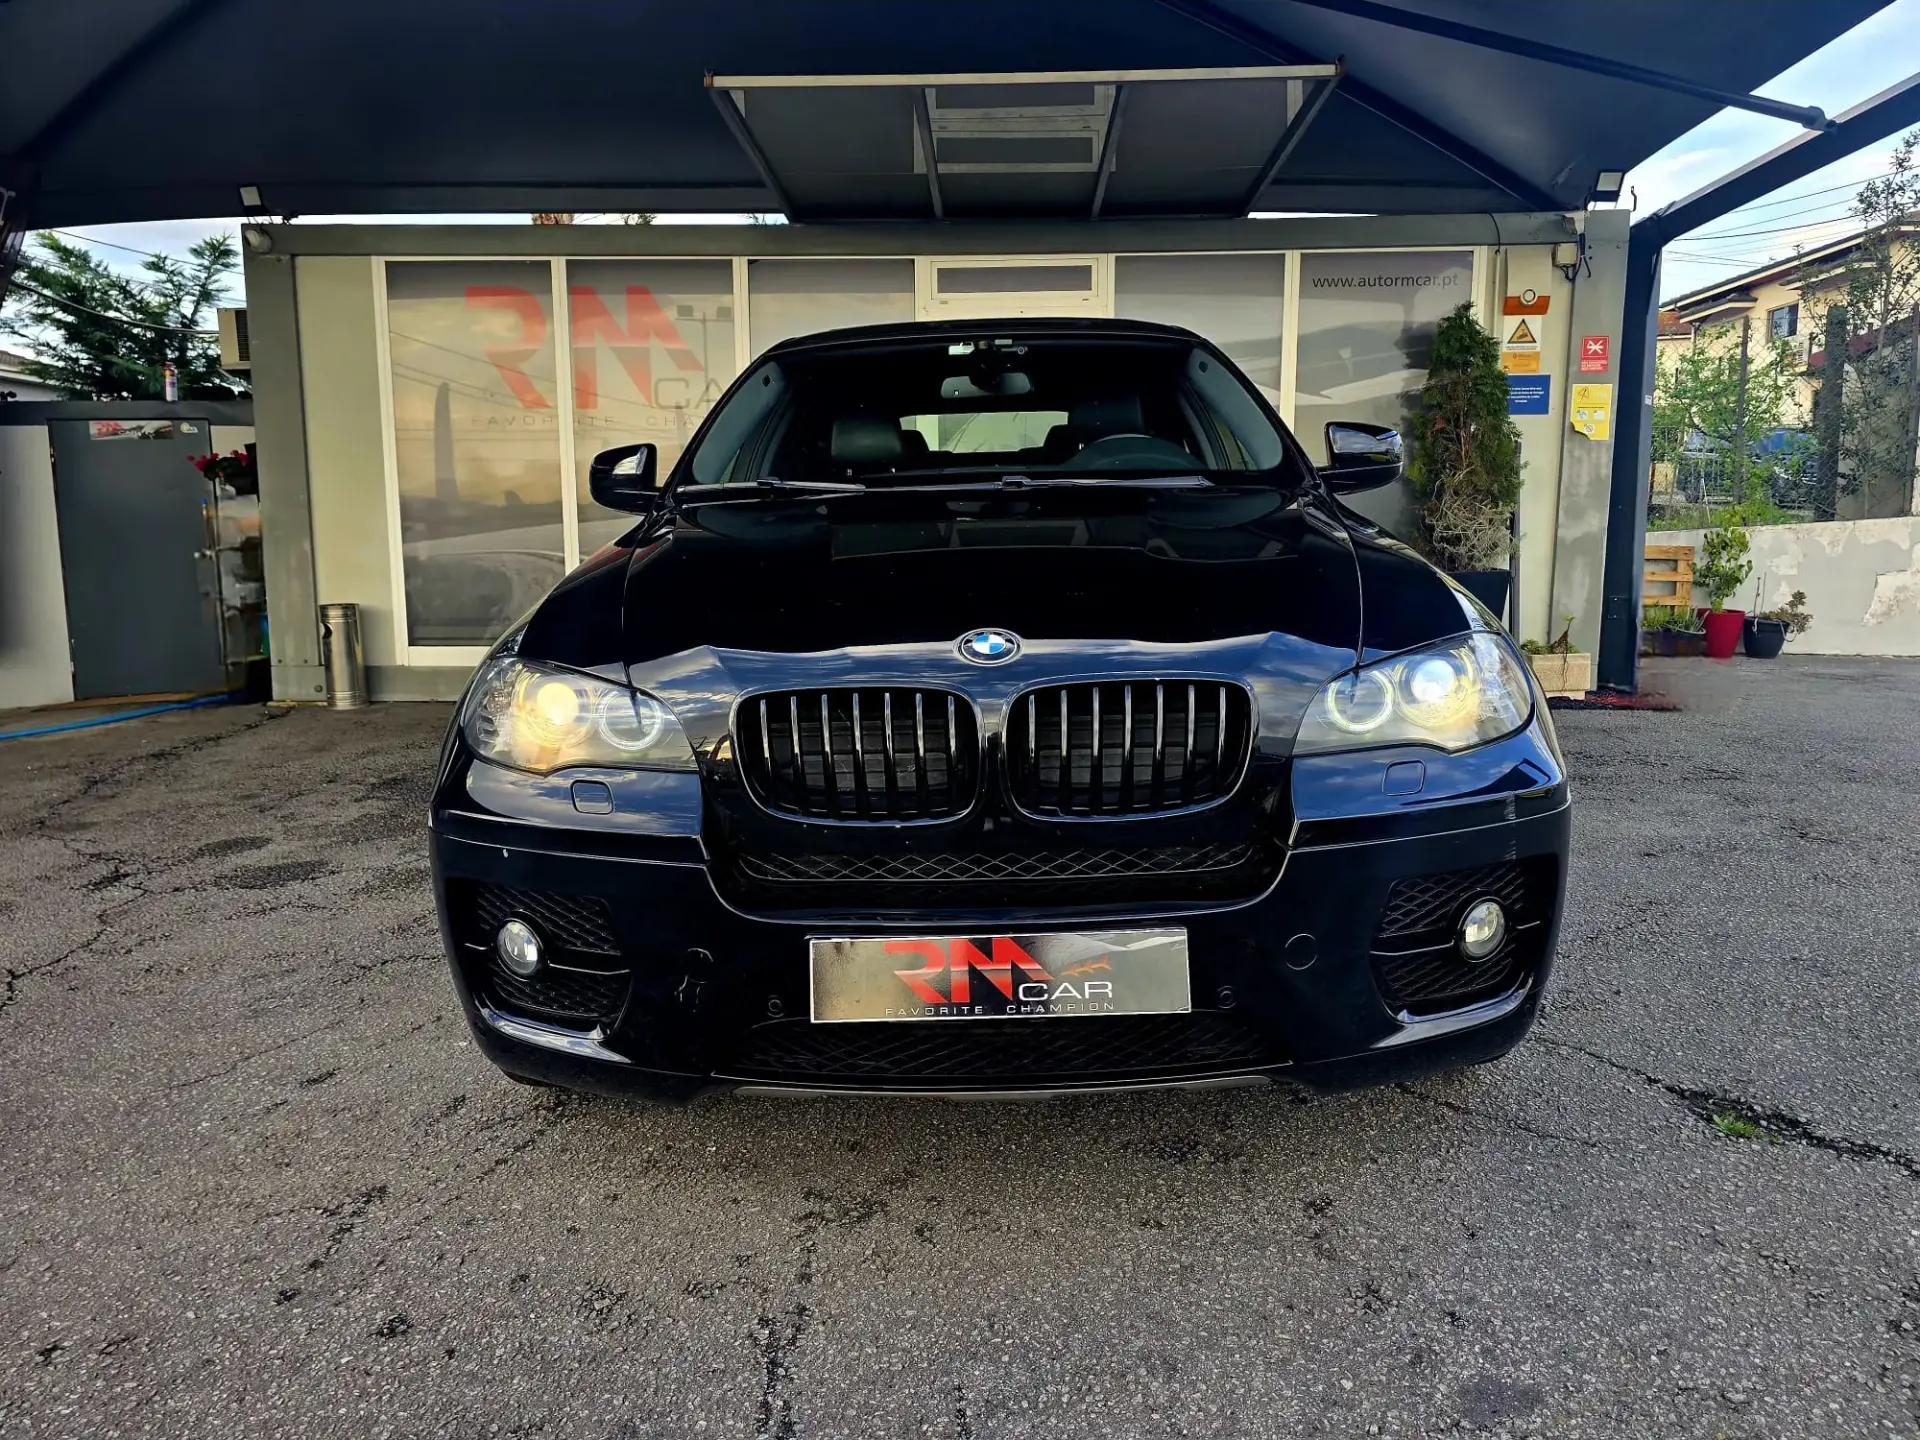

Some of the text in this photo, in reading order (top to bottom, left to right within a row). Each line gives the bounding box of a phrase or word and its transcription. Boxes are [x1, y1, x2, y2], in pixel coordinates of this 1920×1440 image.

[1312, 273, 1458, 289] www.autormcar.pt
[465, 285, 724, 410] RM CA
[471, 416, 616, 427] FAVORITE
[882, 937, 1113, 1003] RM CAR
[885, 1002, 1114, 1016] FAVORITE CHAMPION
